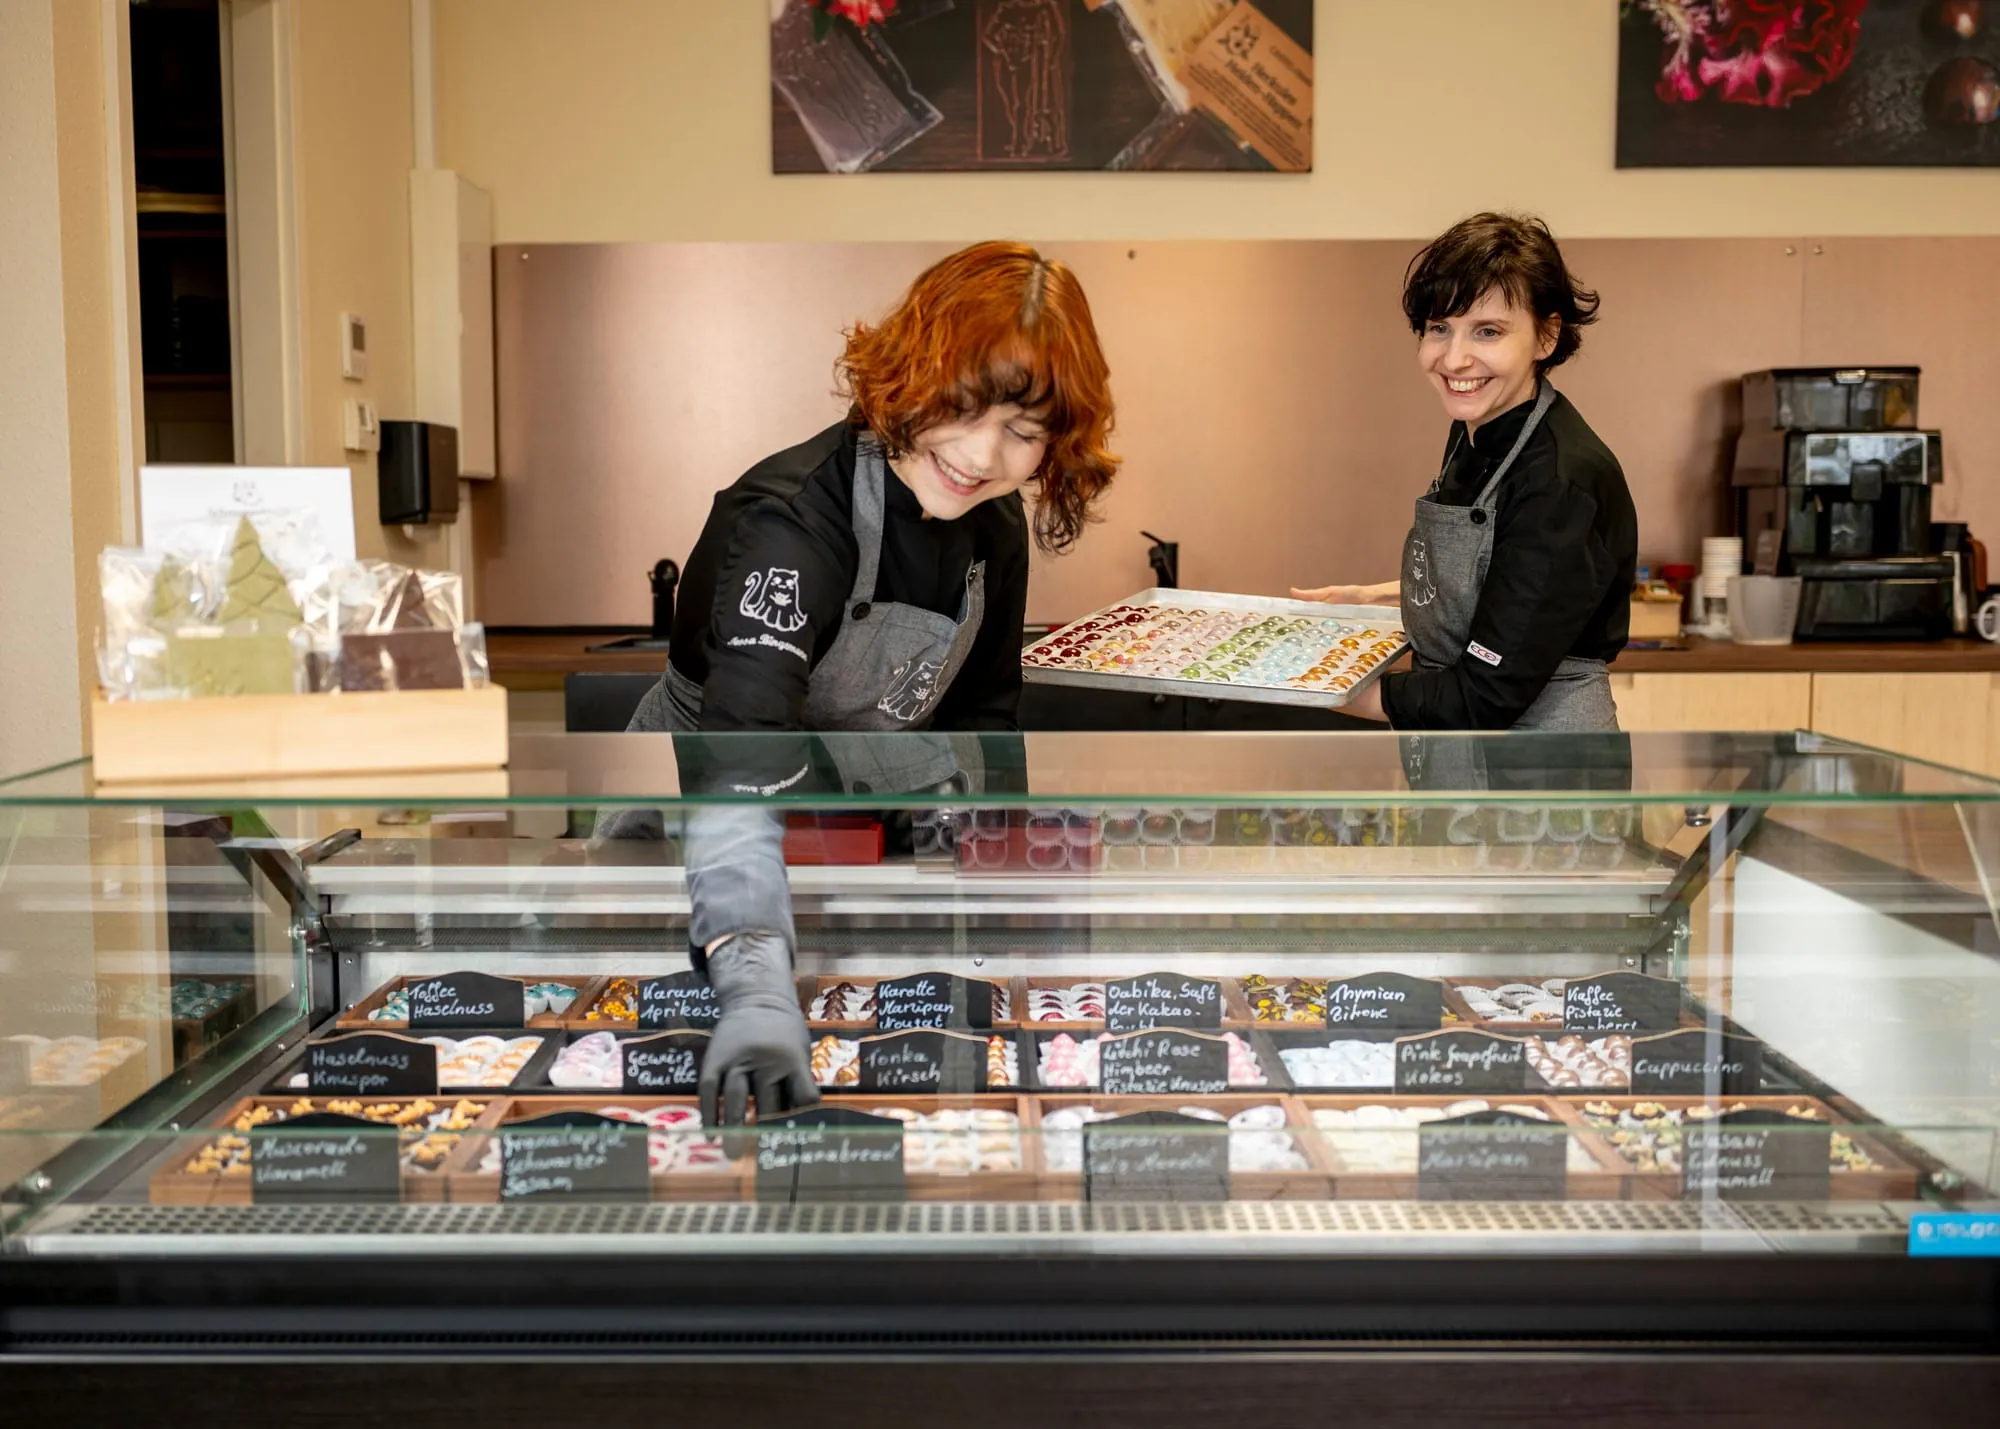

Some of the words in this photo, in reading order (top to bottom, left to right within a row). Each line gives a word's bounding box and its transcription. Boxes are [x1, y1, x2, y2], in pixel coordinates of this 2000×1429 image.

[408, 981, 456, 1003] Toffee
[878, 980, 936, 999] Karotte
[1179, 982, 1216, 1004] Saft
[1330, 984, 1405, 1003] Thymian
[1567, 985, 1614, 1006] Kaffee
[414, 999, 495, 1018] Haselnuss
[878, 1000, 954, 1017] Marzipan
[1108, 1000, 1135, 1016] der
[1330, 1003, 1388, 1022] Zitrone
[1566, 1004, 1622, 1020] Pistazie
[312, 1047, 409, 1070] Haselnuss
[863, 1042, 929, 1069] Tonka
[1103, 1037, 1155, 1060] Litchi
[1157, 1038, 1201, 1058] Rose
[1401, 1040, 1441, 1063] Pink
[638, 1065, 697, 1086] Quitte
[876, 1062, 941, 1088] Kirsch
[1103, 1060, 1171, 1082] Himbeer
[1404, 1065, 1464, 1086] Kokos
[1634, 1054, 1743, 1080] Cappuccino
[1103, 1078, 1168, 1095] Pistazie
